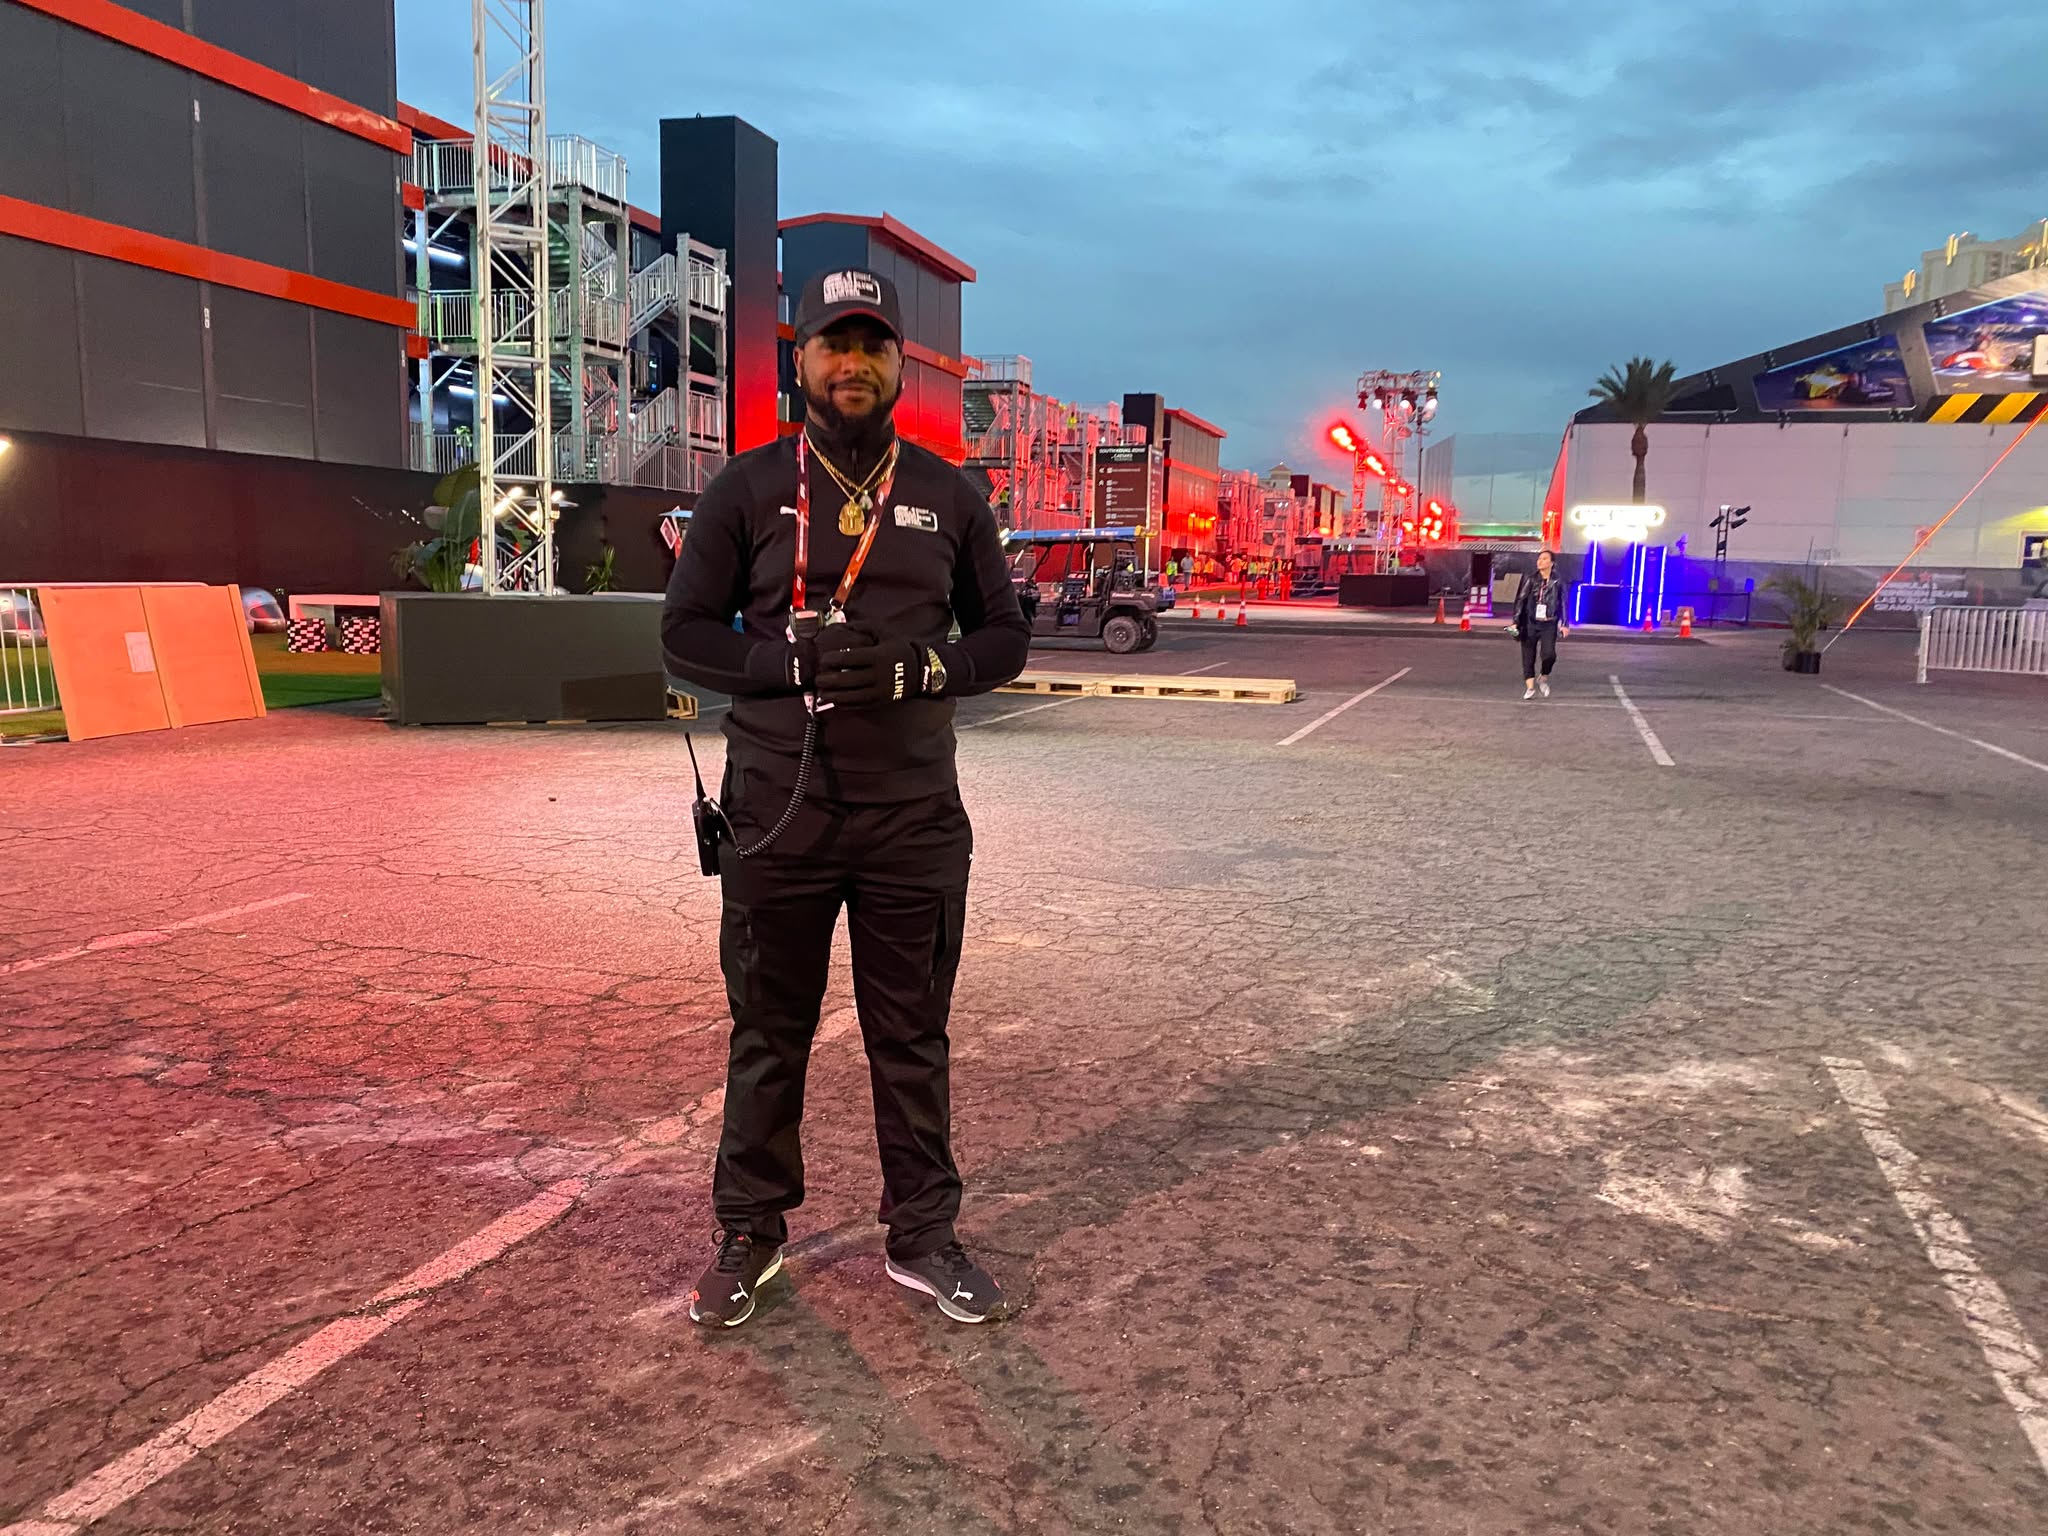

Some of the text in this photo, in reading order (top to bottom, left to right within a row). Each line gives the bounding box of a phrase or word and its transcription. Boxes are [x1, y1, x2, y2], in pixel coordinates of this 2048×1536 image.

[1875, 596, 1937, 605] LAS VEGAS
[893, 661, 904, 700] ULINE
